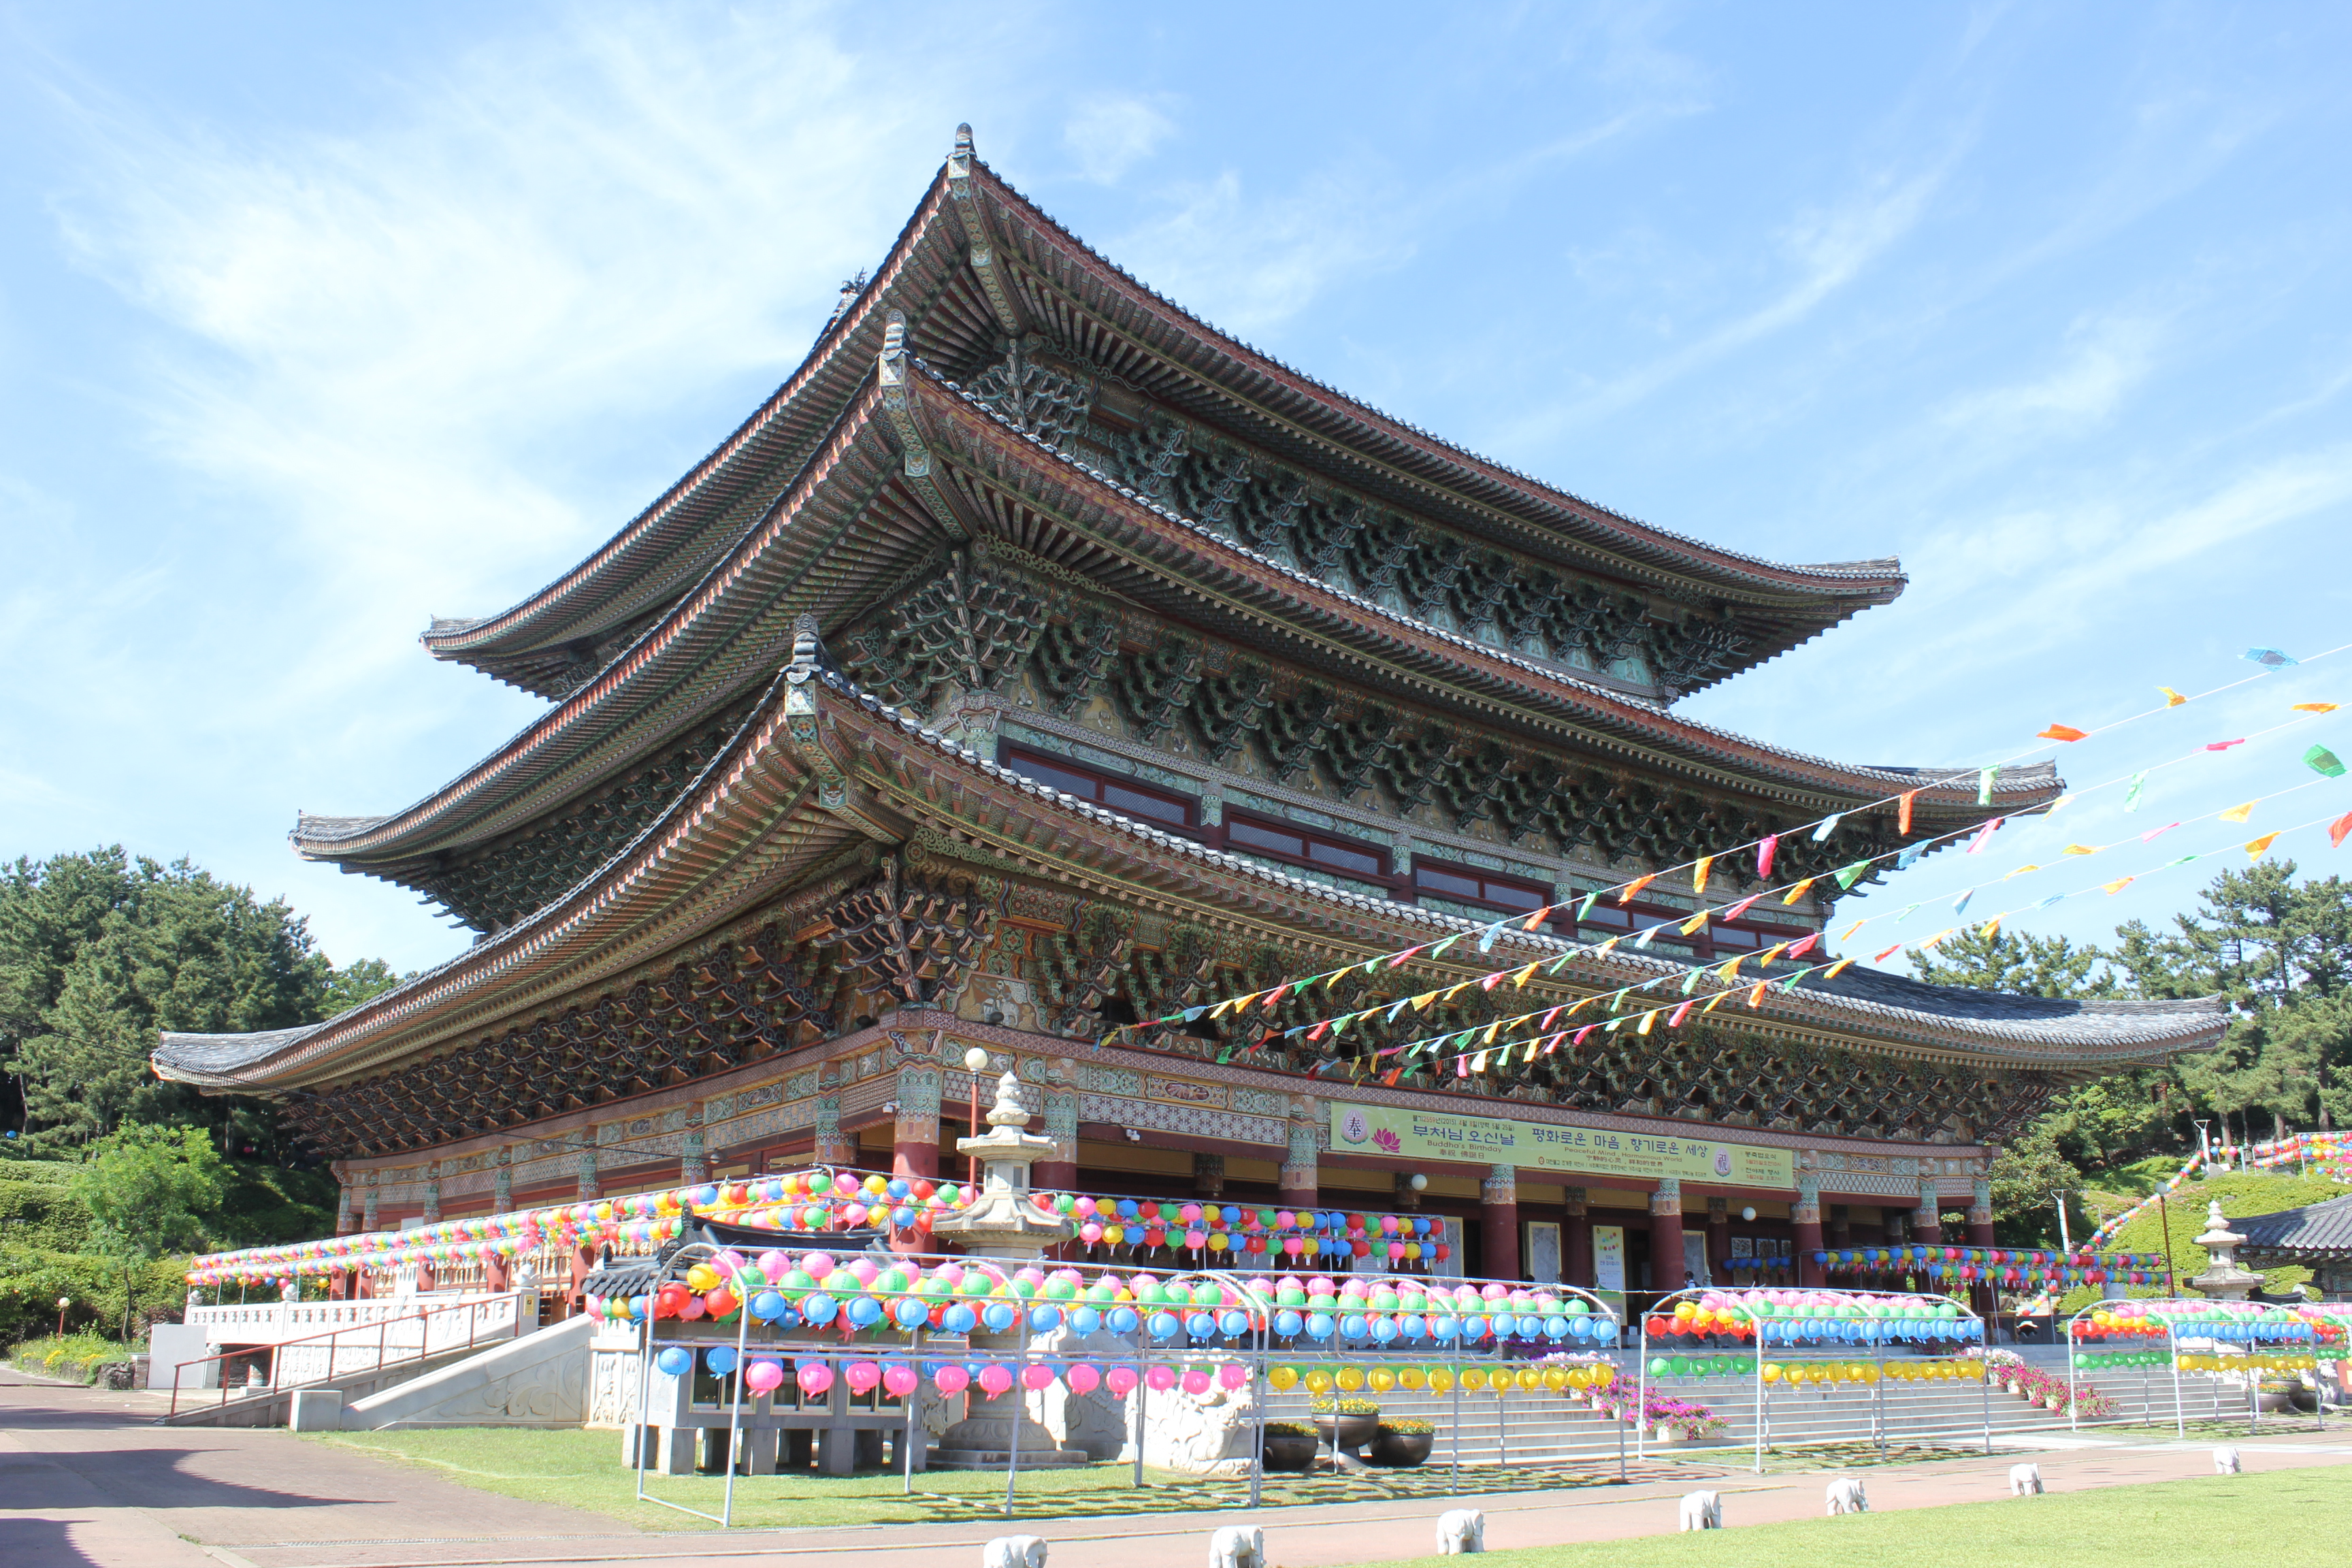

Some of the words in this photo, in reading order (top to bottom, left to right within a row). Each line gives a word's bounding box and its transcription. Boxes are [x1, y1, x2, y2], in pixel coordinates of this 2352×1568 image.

[1348, 1117, 1361, 1137] 奉
[1413, 1125, 1463, 1141] 부처님
[1467, 1130, 1515, 1146] 오신날
[1469, 1144, 1502, 1154] Birthday
[1532, 1128, 1586, 1146] 평화로운
[1630, 1138, 1680, 1155] 향기로운
[1685, 1144, 1708, 1158] 세상
[1564, 1147, 1595, 1155] Peaceful
[1622, 1152, 1662, 1161] Harmonious
[1745, 1151, 1777, 1160] 봉축법요식
